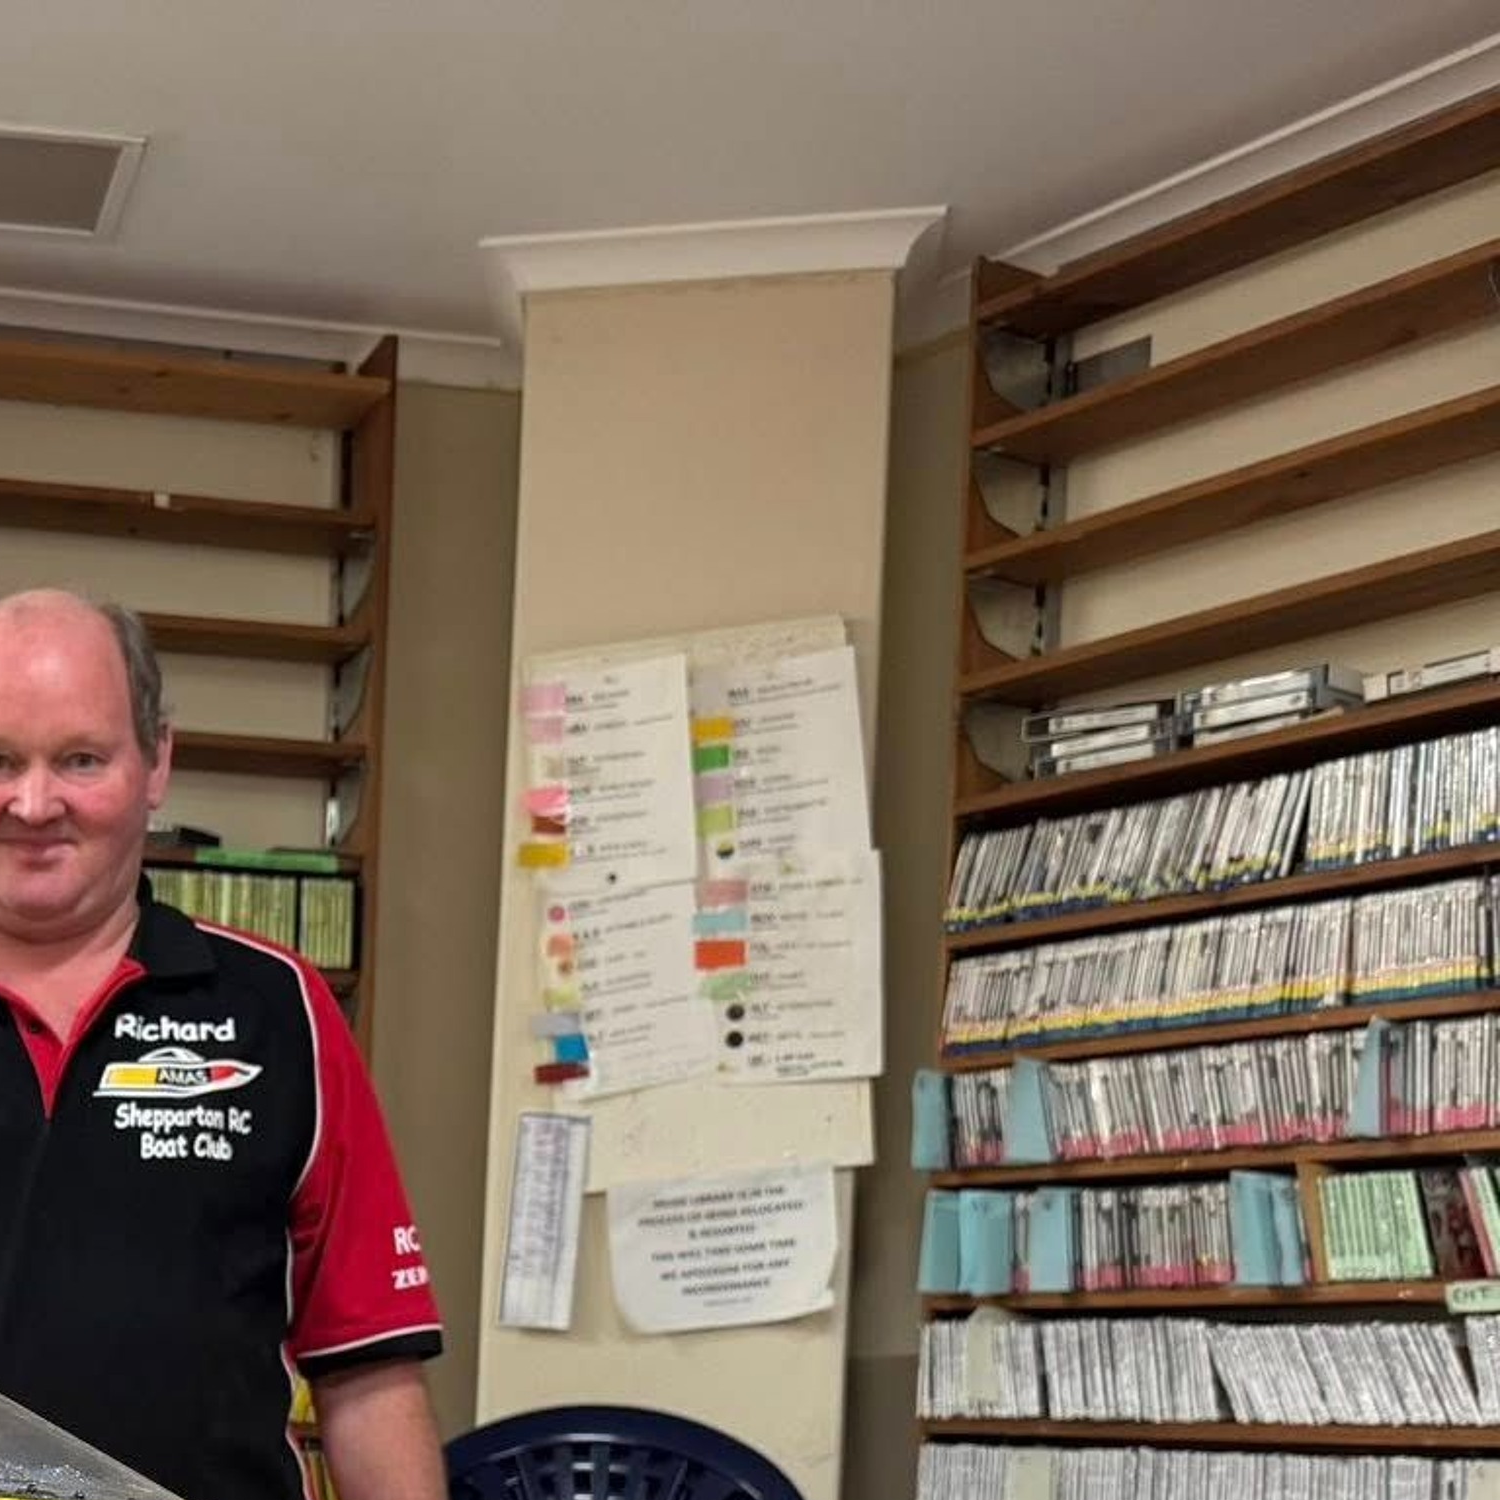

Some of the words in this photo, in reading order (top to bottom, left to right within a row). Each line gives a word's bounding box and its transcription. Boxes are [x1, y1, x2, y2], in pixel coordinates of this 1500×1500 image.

[114, 1013, 236, 1042] Richard
[158, 1067, 208, 1084] AMAS
[113, 1101, 225, 1134] Shepparton
[227, 1107, 252, 1135] RC
[139, 1131, 189, 1160] Boat
[192, 1132, 233, 1161] Club
